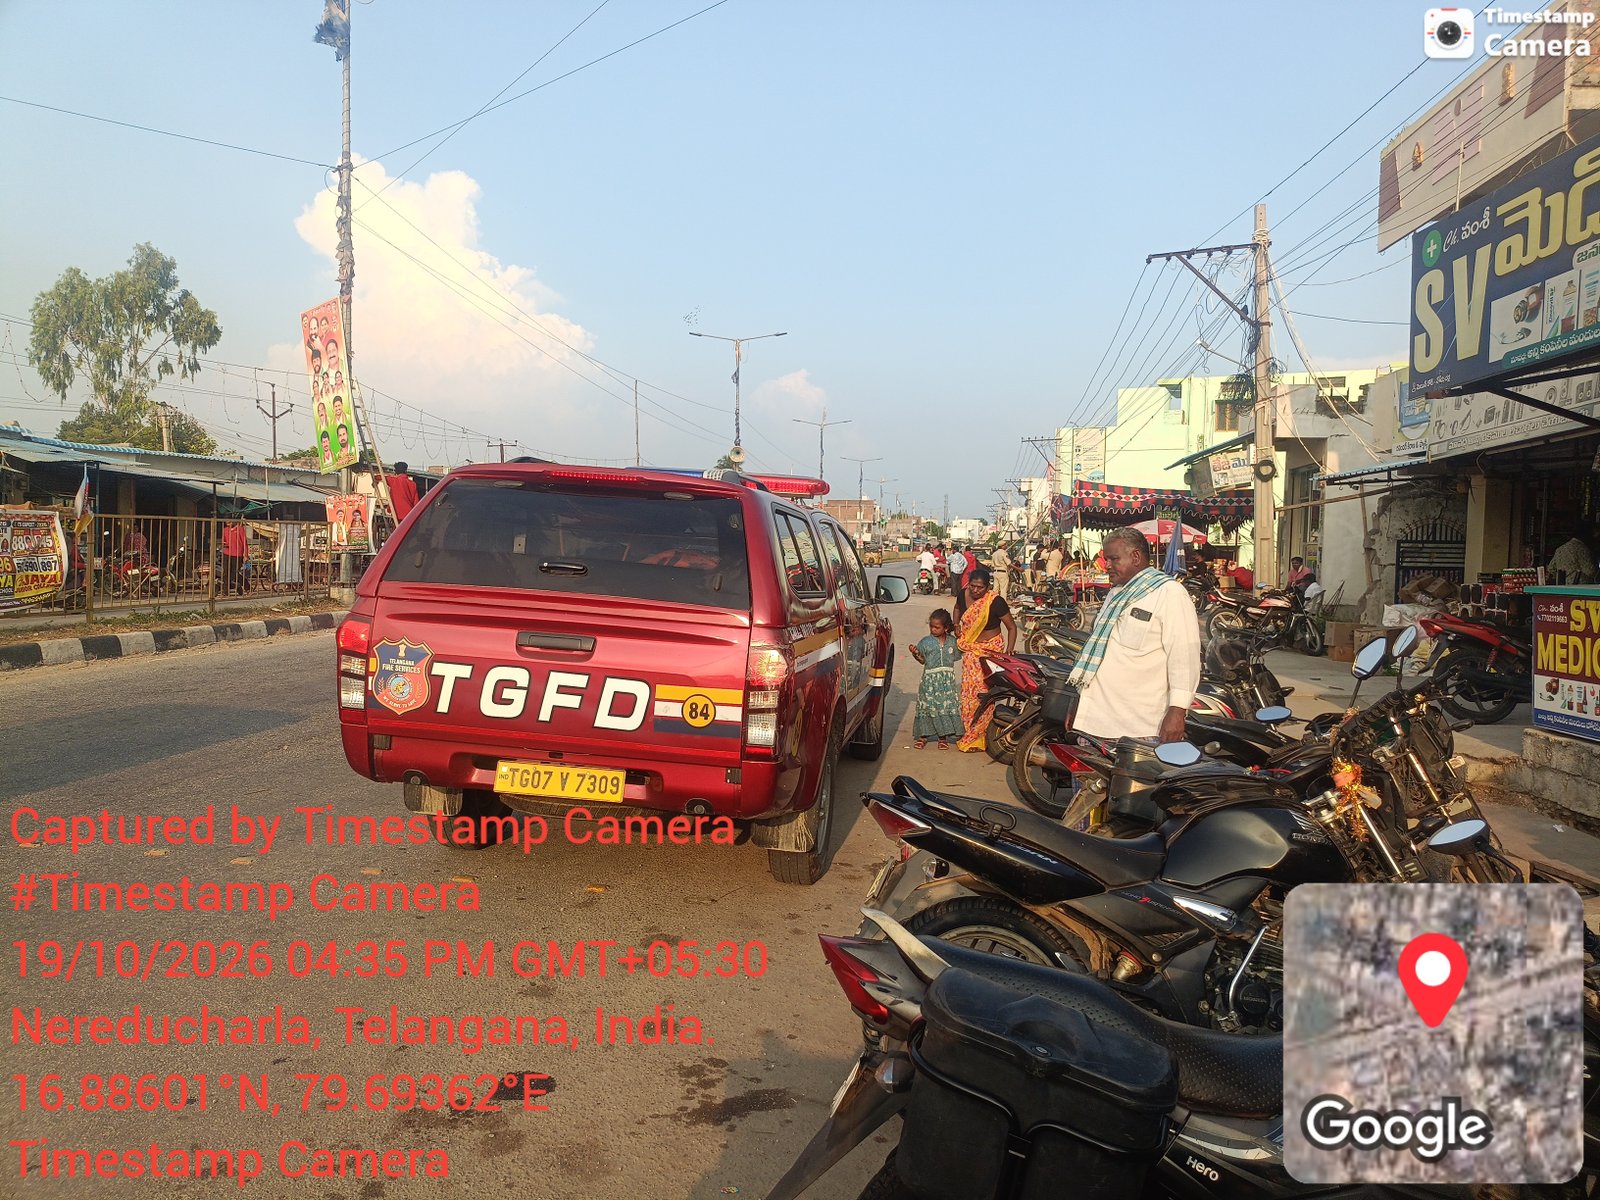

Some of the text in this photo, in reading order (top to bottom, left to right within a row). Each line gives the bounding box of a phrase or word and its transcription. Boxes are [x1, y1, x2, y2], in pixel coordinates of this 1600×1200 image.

[1414, 243, 1492, 373] SV
[382, 663, 421, 674] FIRE SERVICES
[431, 662, 651, 732] TGFD
[688, 703, 711, 721] 84
[509, 767, 620, 795] TG07 V 7309
[1186, 1155, 1219, 1181] Hero
